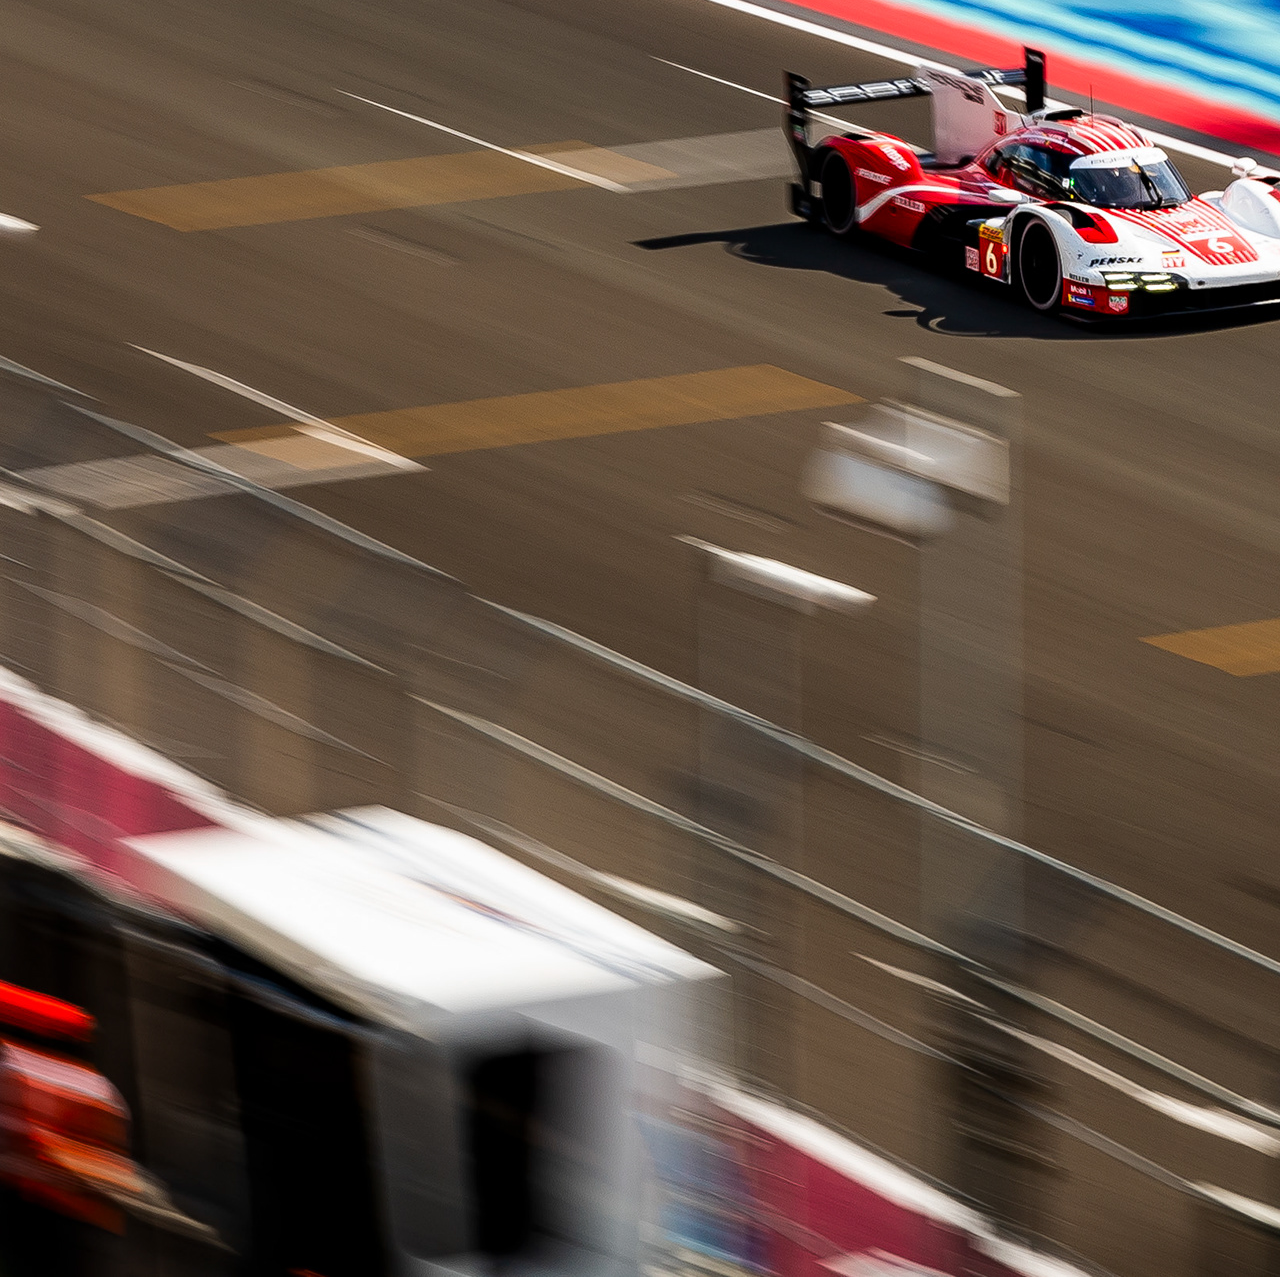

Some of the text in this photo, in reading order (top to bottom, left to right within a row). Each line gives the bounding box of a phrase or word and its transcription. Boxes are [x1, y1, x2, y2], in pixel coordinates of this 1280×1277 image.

[1207, 237, 1235, 253] 6
[986, 242, 998, 274] 6
[1089, 256, 1144, 267] PENSKE
